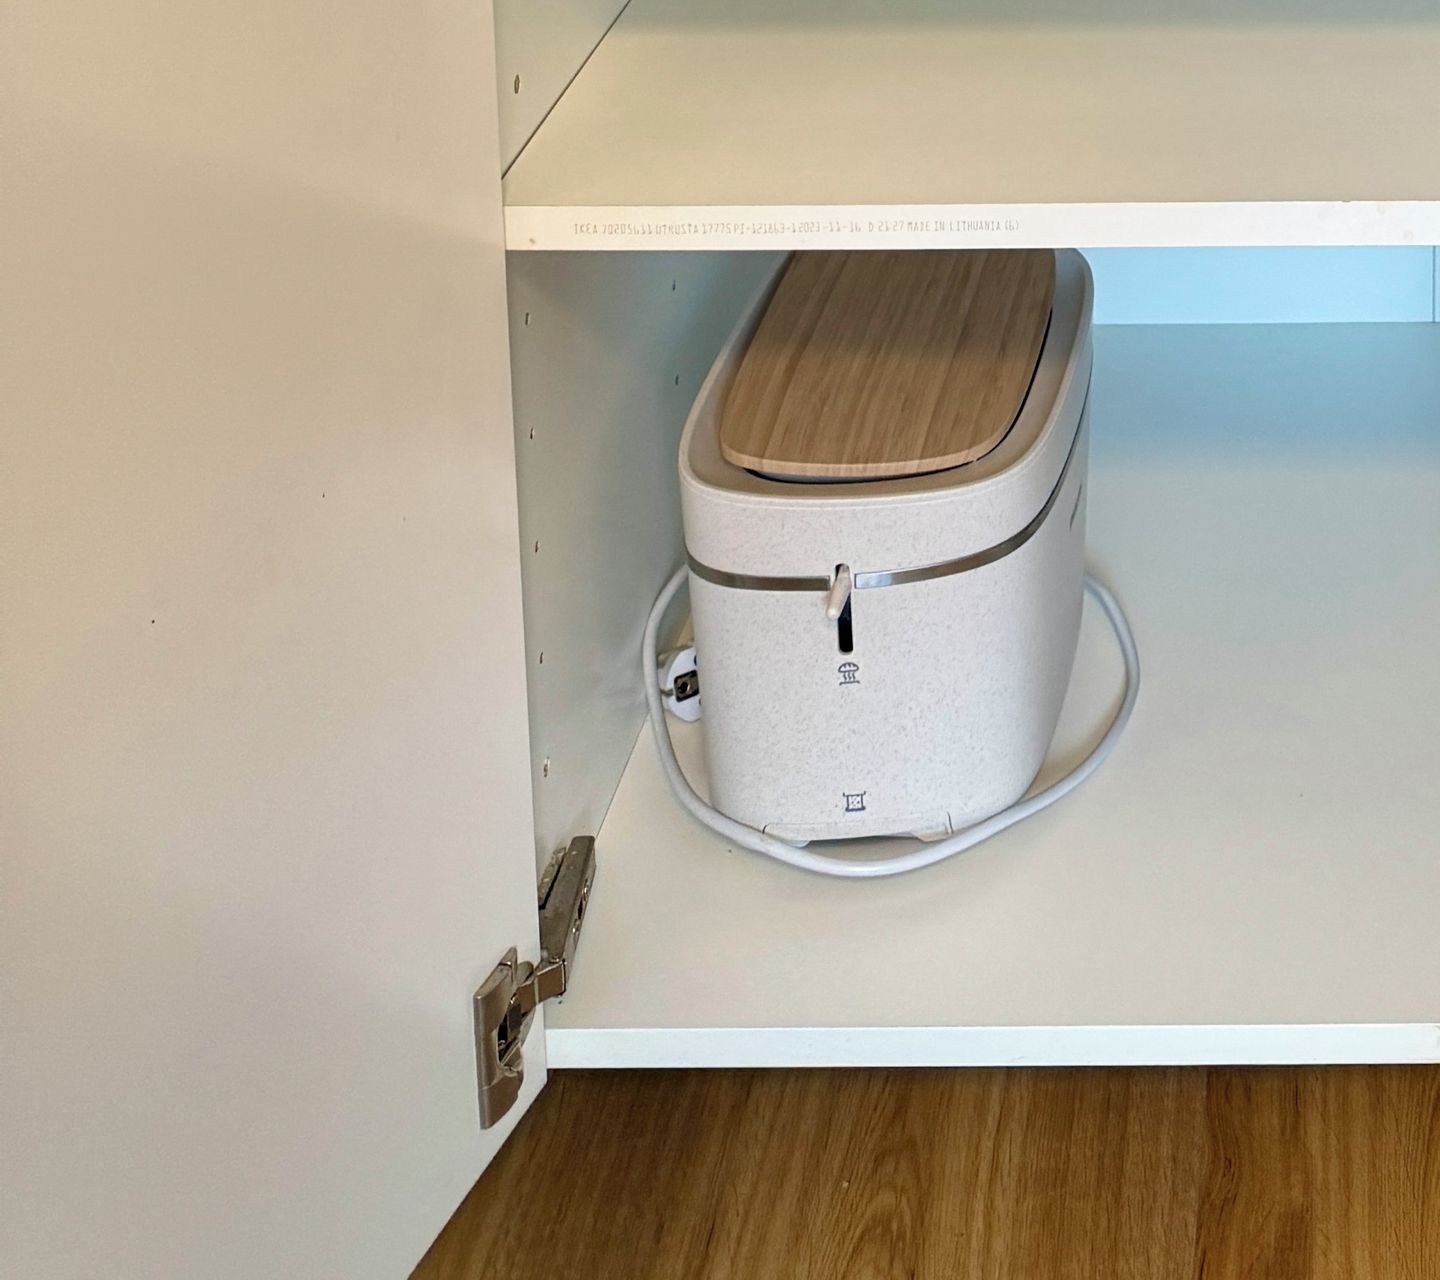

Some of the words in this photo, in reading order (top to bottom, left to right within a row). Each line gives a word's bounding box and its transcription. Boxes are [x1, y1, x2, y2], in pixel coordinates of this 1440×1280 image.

[574, 223, 598, 235] IKEA
[655, 222, 699, 236] UTRUSTA
[907, 221, 931, 232] MADE
[934, 221, 945, 232] IN
[949, 220, 1001, 232] LITHUANIA
